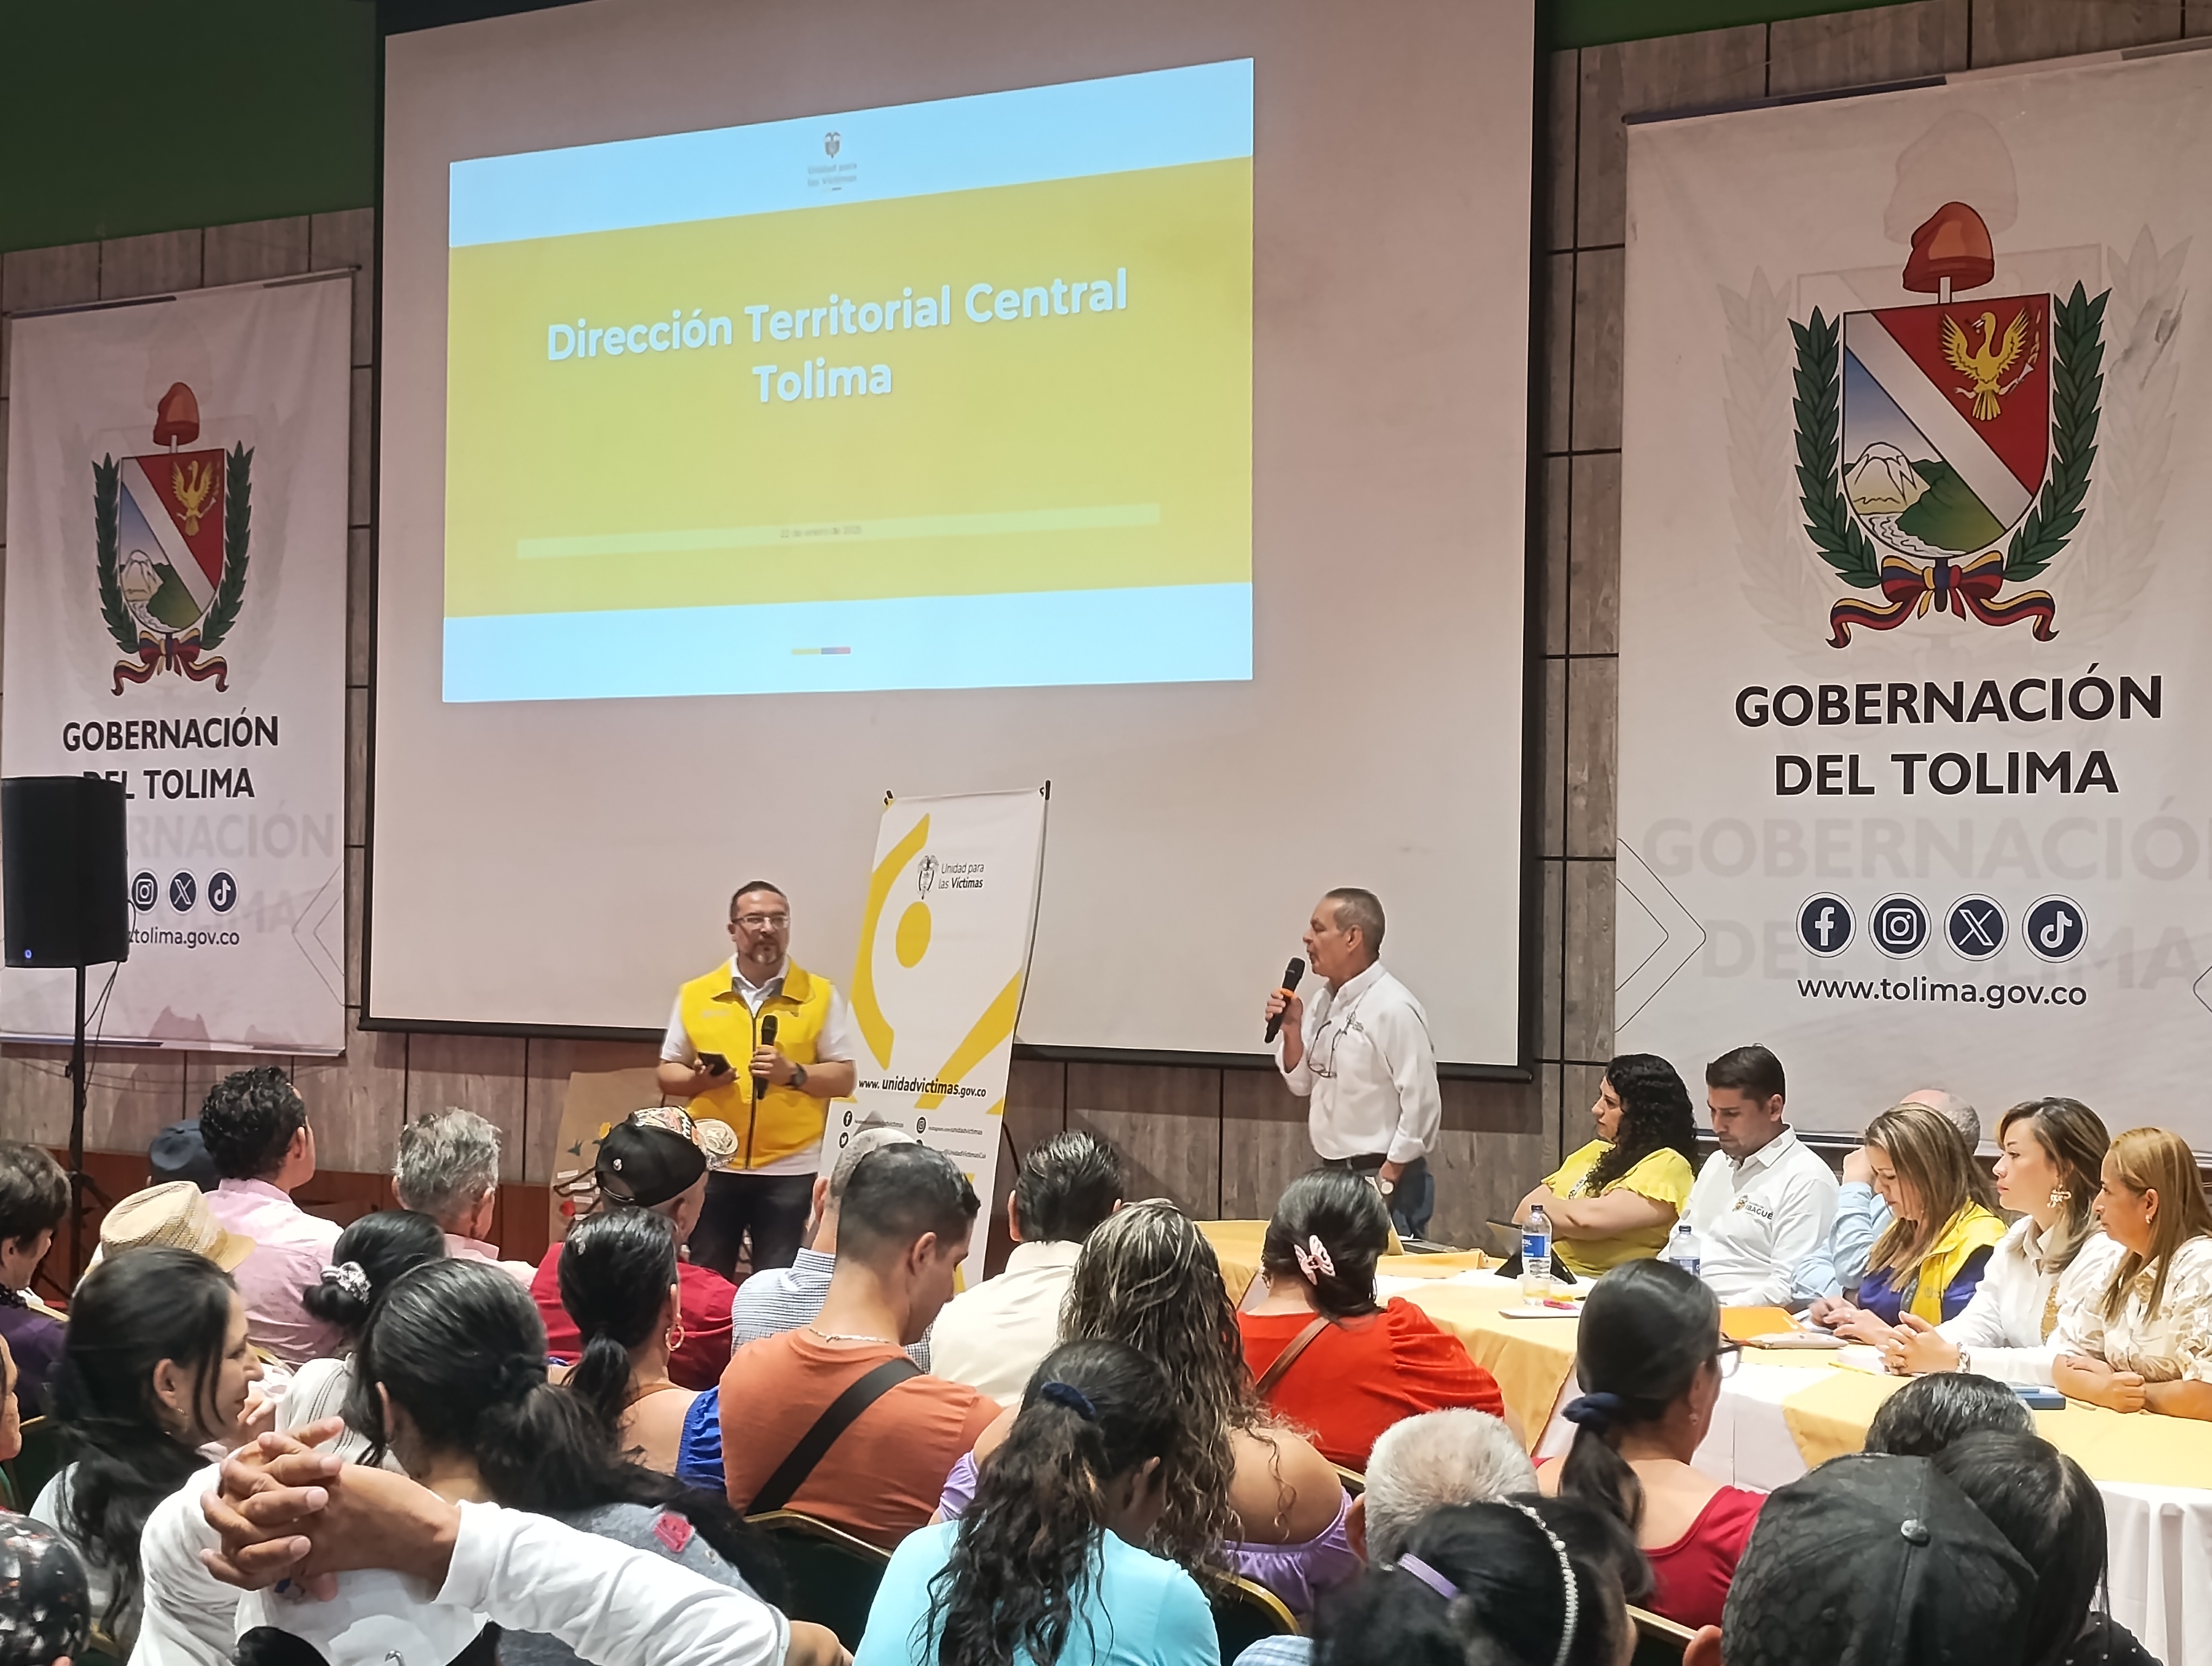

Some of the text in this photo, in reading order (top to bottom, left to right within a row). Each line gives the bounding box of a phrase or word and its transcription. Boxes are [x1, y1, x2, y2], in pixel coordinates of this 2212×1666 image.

[548, 267, 1127, 361] Dirección Territorial Central
[753, 357, 891, 402] Tolima
[1735, 662, 2162, 728] GOBERNACIÓN
[63, 707, 279, 752] GOBERNACIÓN
[143, 767, 255, 799] TOLIMA
[1775, 750, 2119, 796] DEL TOLIMA
[1643, 796, 2212, 881] GOBERNACIÓ
[938, 876, 983, 889] las Víctimas
[941, 862, 985, 875] Unidad para
[1797, 976, 2087, 1009] www.tolima.gov.co
